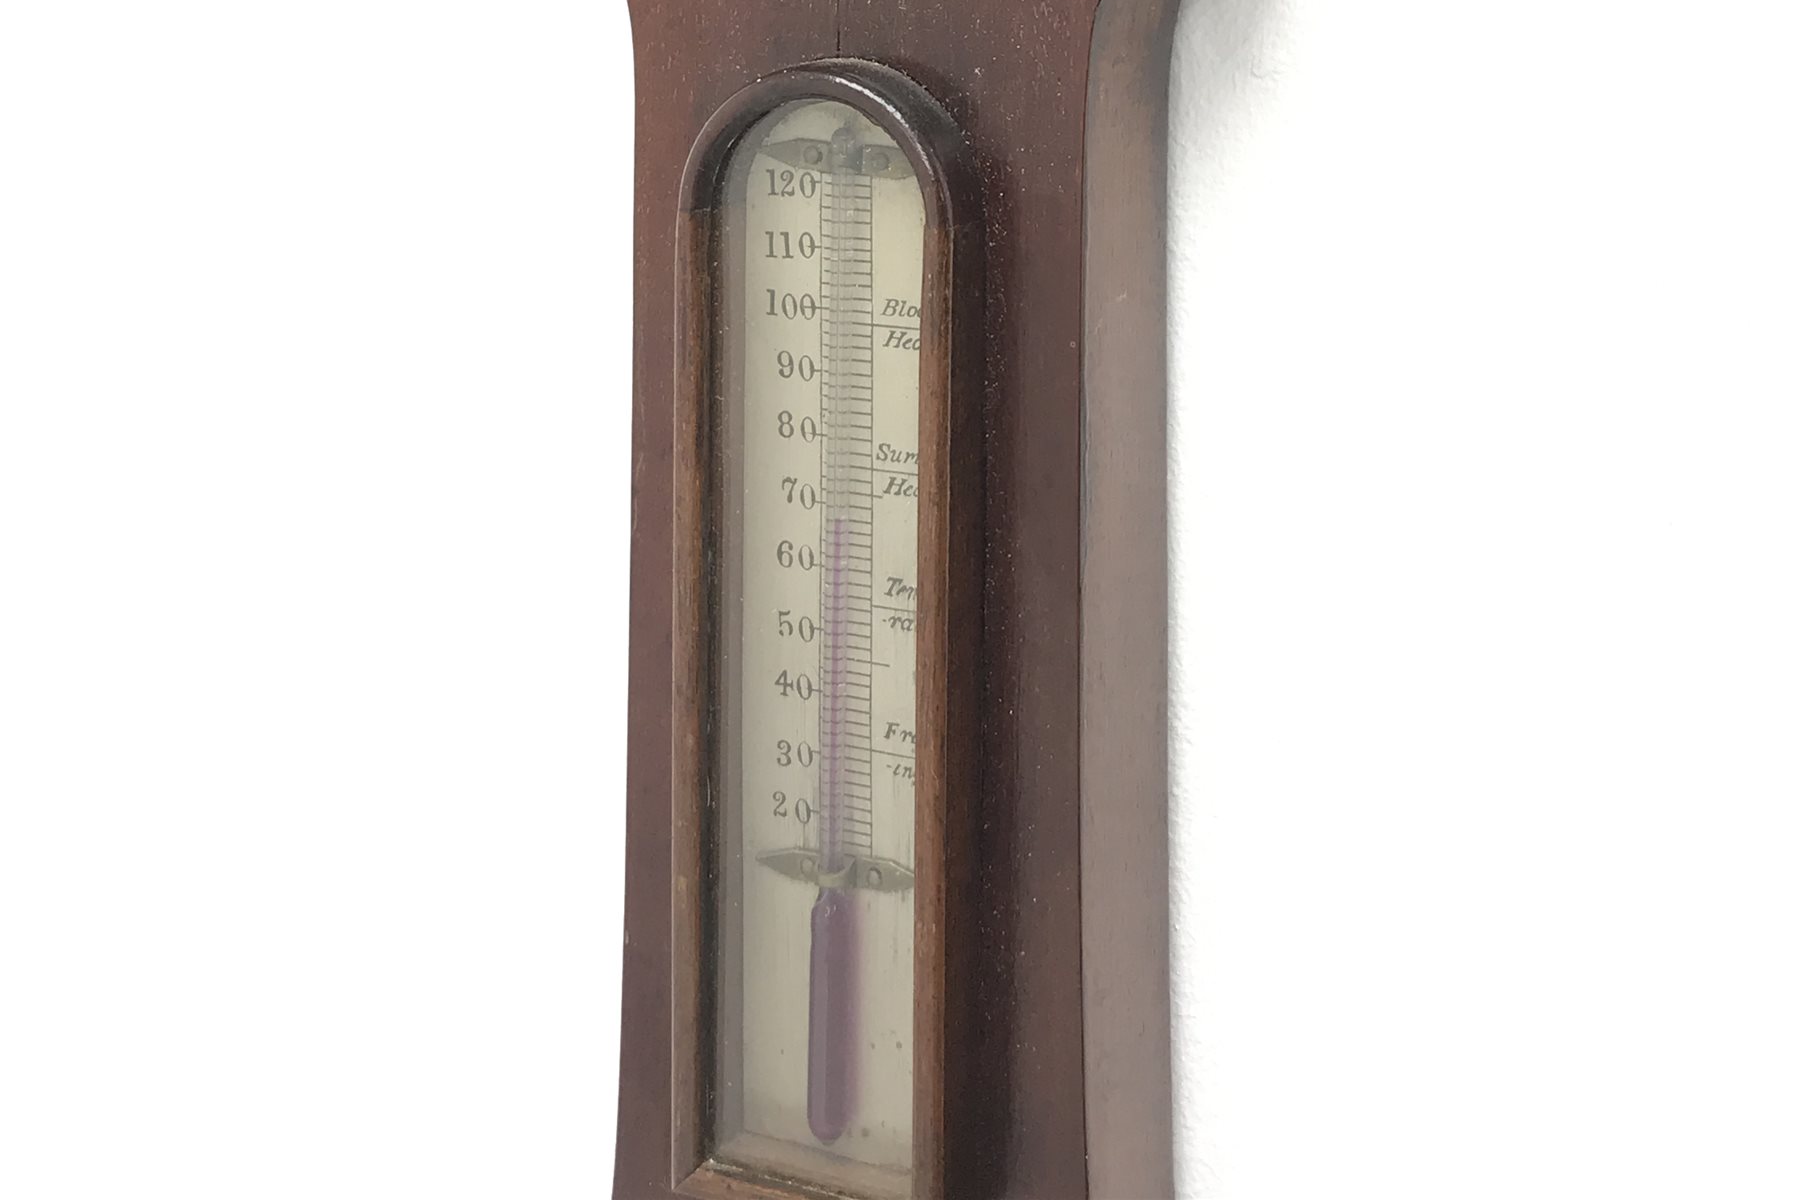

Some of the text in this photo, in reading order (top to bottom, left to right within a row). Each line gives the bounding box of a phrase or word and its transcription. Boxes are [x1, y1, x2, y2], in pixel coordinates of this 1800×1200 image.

[766, 169, 816, 198] 120
[765, 231, 816, 259] 110
[766, 289, 816, 320] 100
[777, 350, 815, 381] 90
[778, 410, 816, 443] 80
[781, 477, 816, 509] 70
[777, 540, 815, 571] 60
[778, 610, 815, 642] 50
[774, 670, 812, 700] 40
[776, 740, 813, 767] 30
[772, 791, 811, 824] 20
